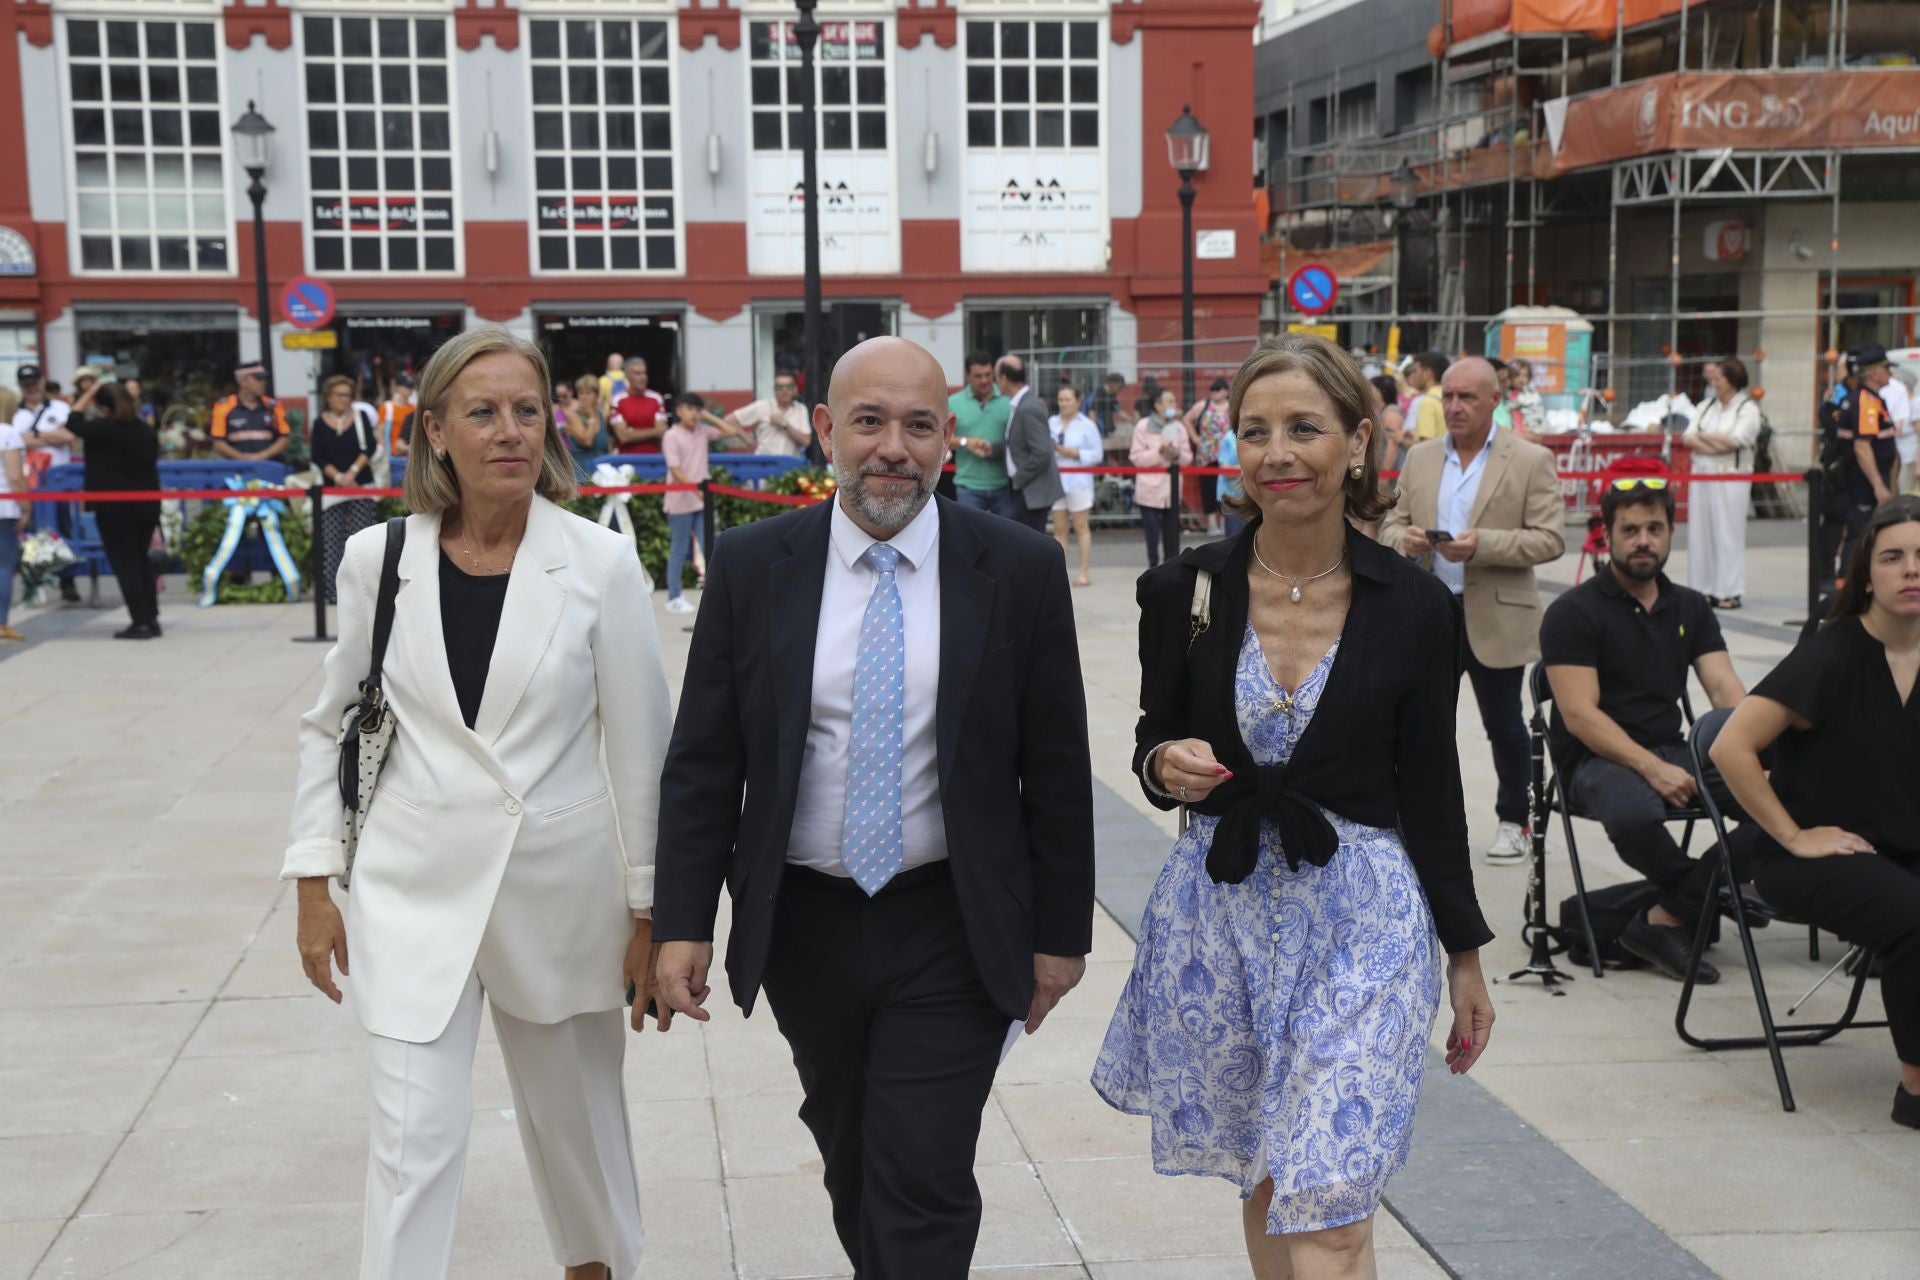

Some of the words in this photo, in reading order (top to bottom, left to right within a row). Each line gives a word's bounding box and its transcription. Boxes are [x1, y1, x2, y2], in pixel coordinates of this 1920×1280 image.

[840, 24, 875, 41] VNDE
[1681, 99, 1748, 128] ING
[316, 206, 332, 219] La
[333, 206, 361, 219] Csa
[363, 206, 389, 219] Rel
[408, 207, 449, 222] Jmon
[542, 206, 557, 218] La
[558, 206, 585, 218] Csa
[587, 206, 611, 218] Rel
[628, 206, 668, 221] Jmon
